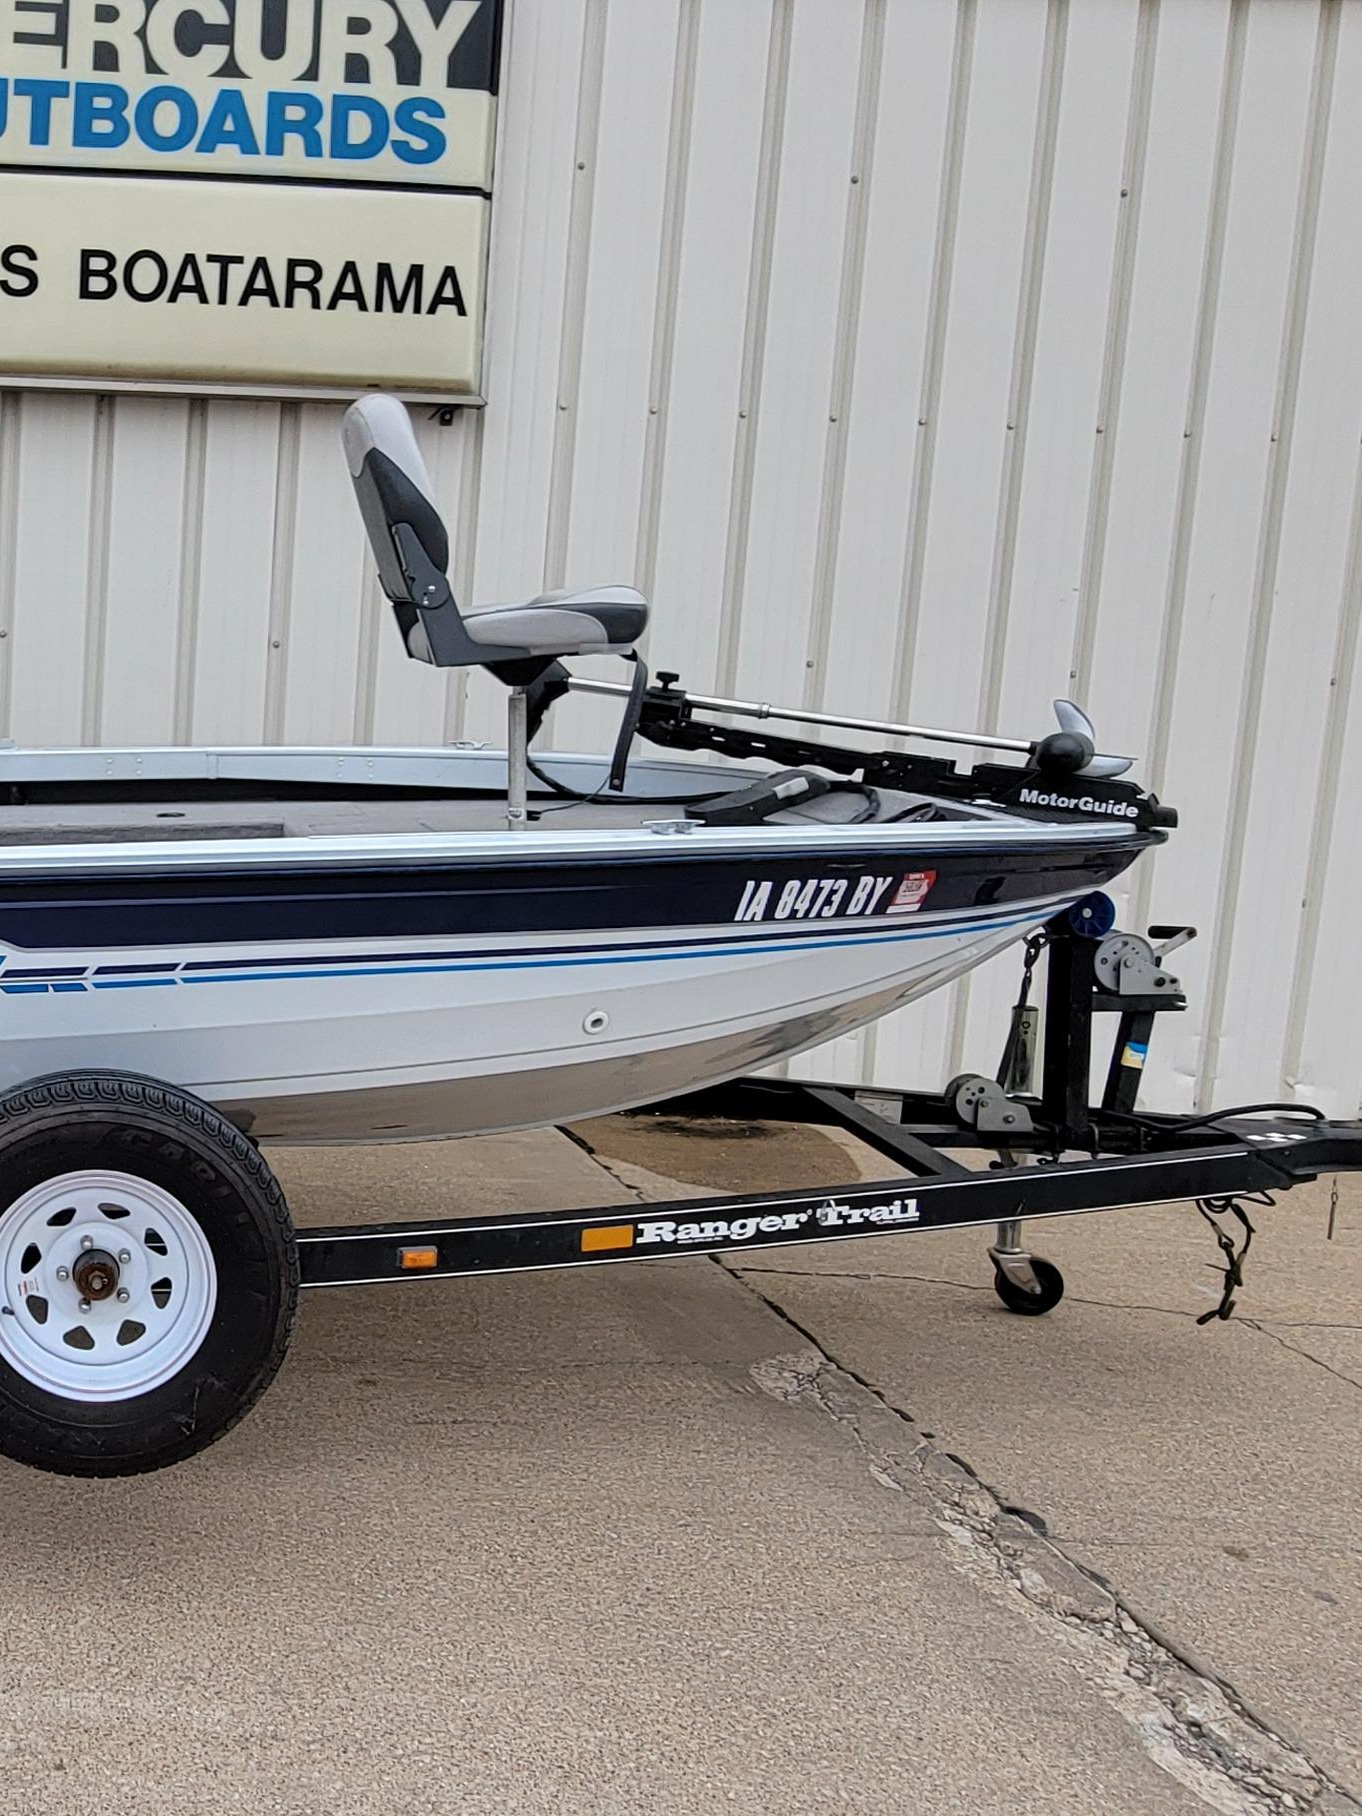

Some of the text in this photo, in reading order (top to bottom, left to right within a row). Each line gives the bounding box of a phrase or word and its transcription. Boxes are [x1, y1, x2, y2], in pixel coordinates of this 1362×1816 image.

[79, 249, 468, 317] BOATARAMA
[1019, 788, 1139, 818] MotorGuide
[734, 875, 893, 921] IA 8473 BY
[636, 1199, 920, 1242] Ranger Trail
